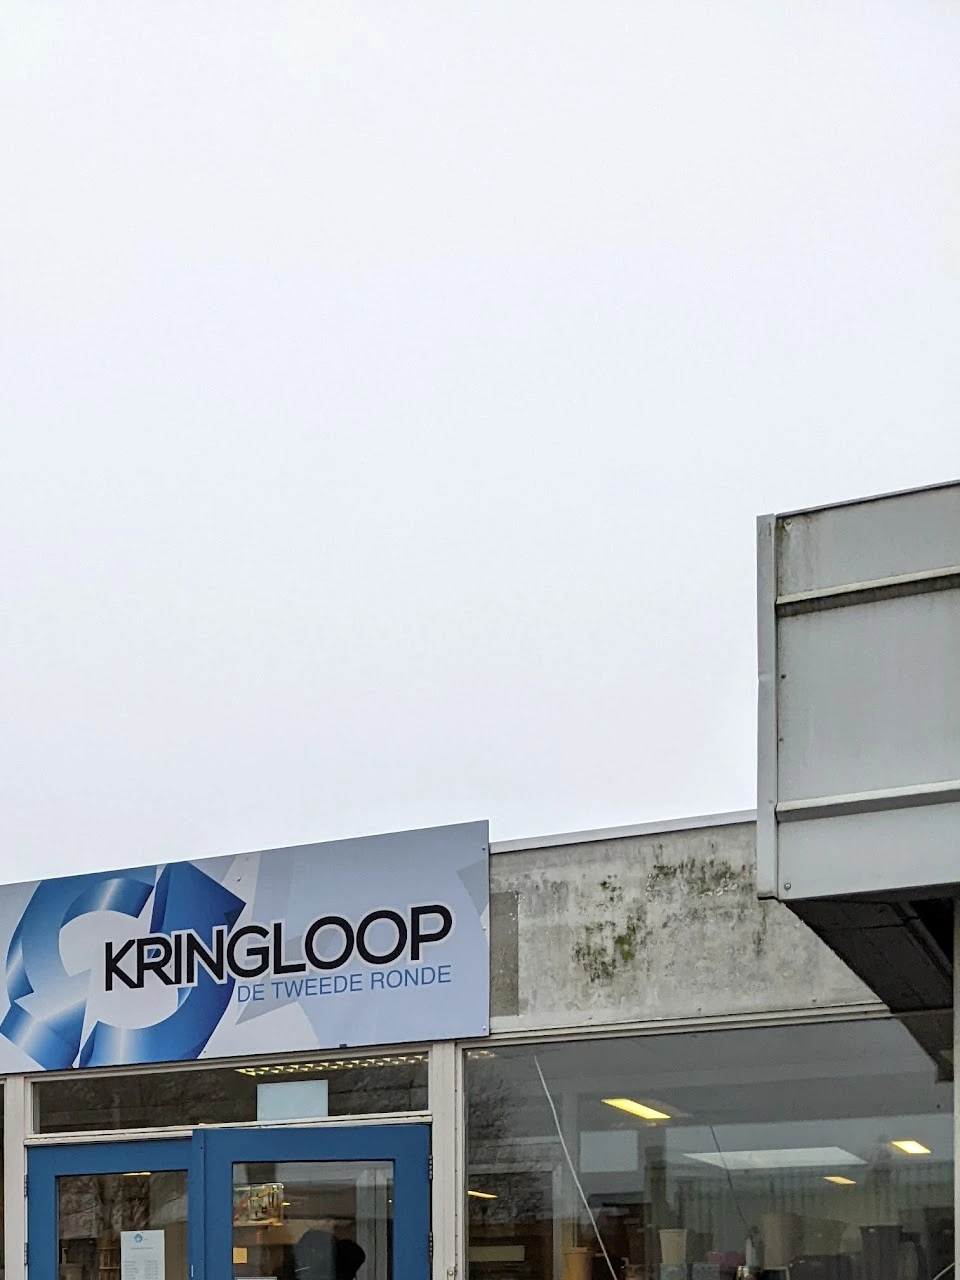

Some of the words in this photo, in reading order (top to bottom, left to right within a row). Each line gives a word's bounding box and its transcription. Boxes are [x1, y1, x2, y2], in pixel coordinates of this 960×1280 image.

[105, 904, 453, 992] KRINGLOOP
[237, 983, 265, 1003] DE
[271, 973, 363, 999] TWEEDE
[370, 965, 452, 990] RONDE
